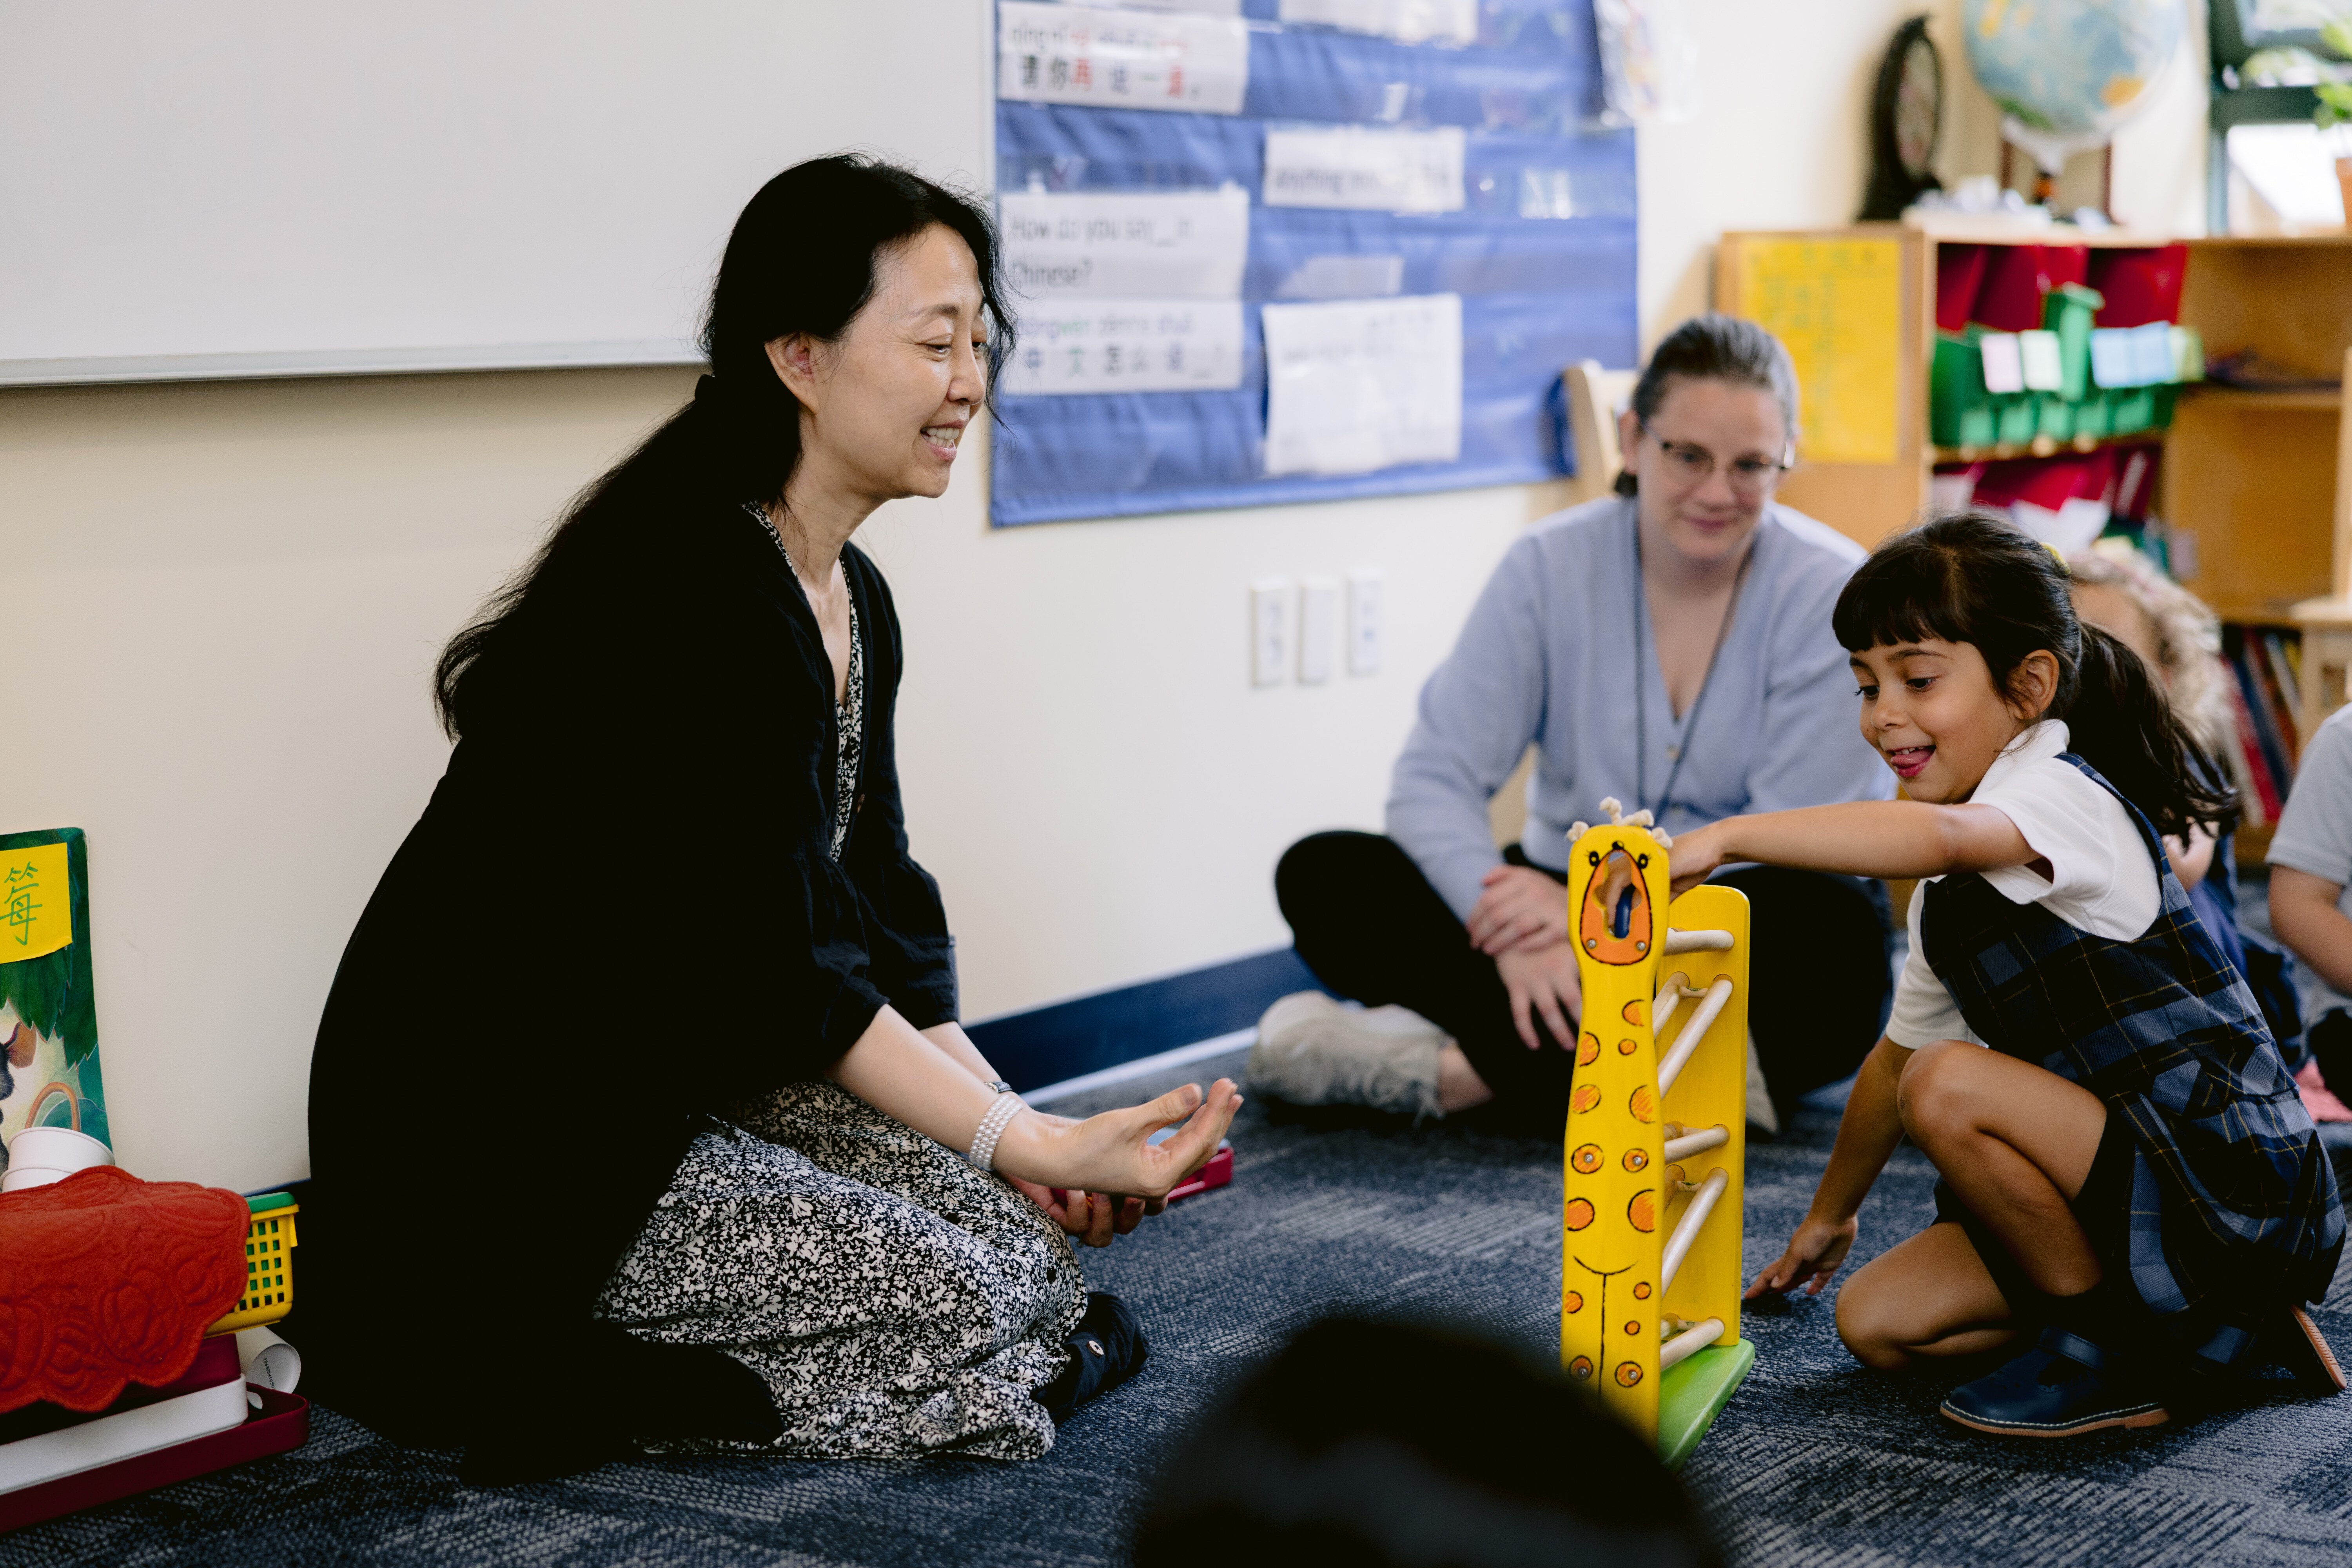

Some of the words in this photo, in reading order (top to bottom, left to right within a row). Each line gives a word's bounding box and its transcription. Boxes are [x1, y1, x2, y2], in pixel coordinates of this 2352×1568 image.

[1012, 218, 1050, 241] How
[1058, 217, 1080, 240] do
[1085, 219, 1120, 247] you
